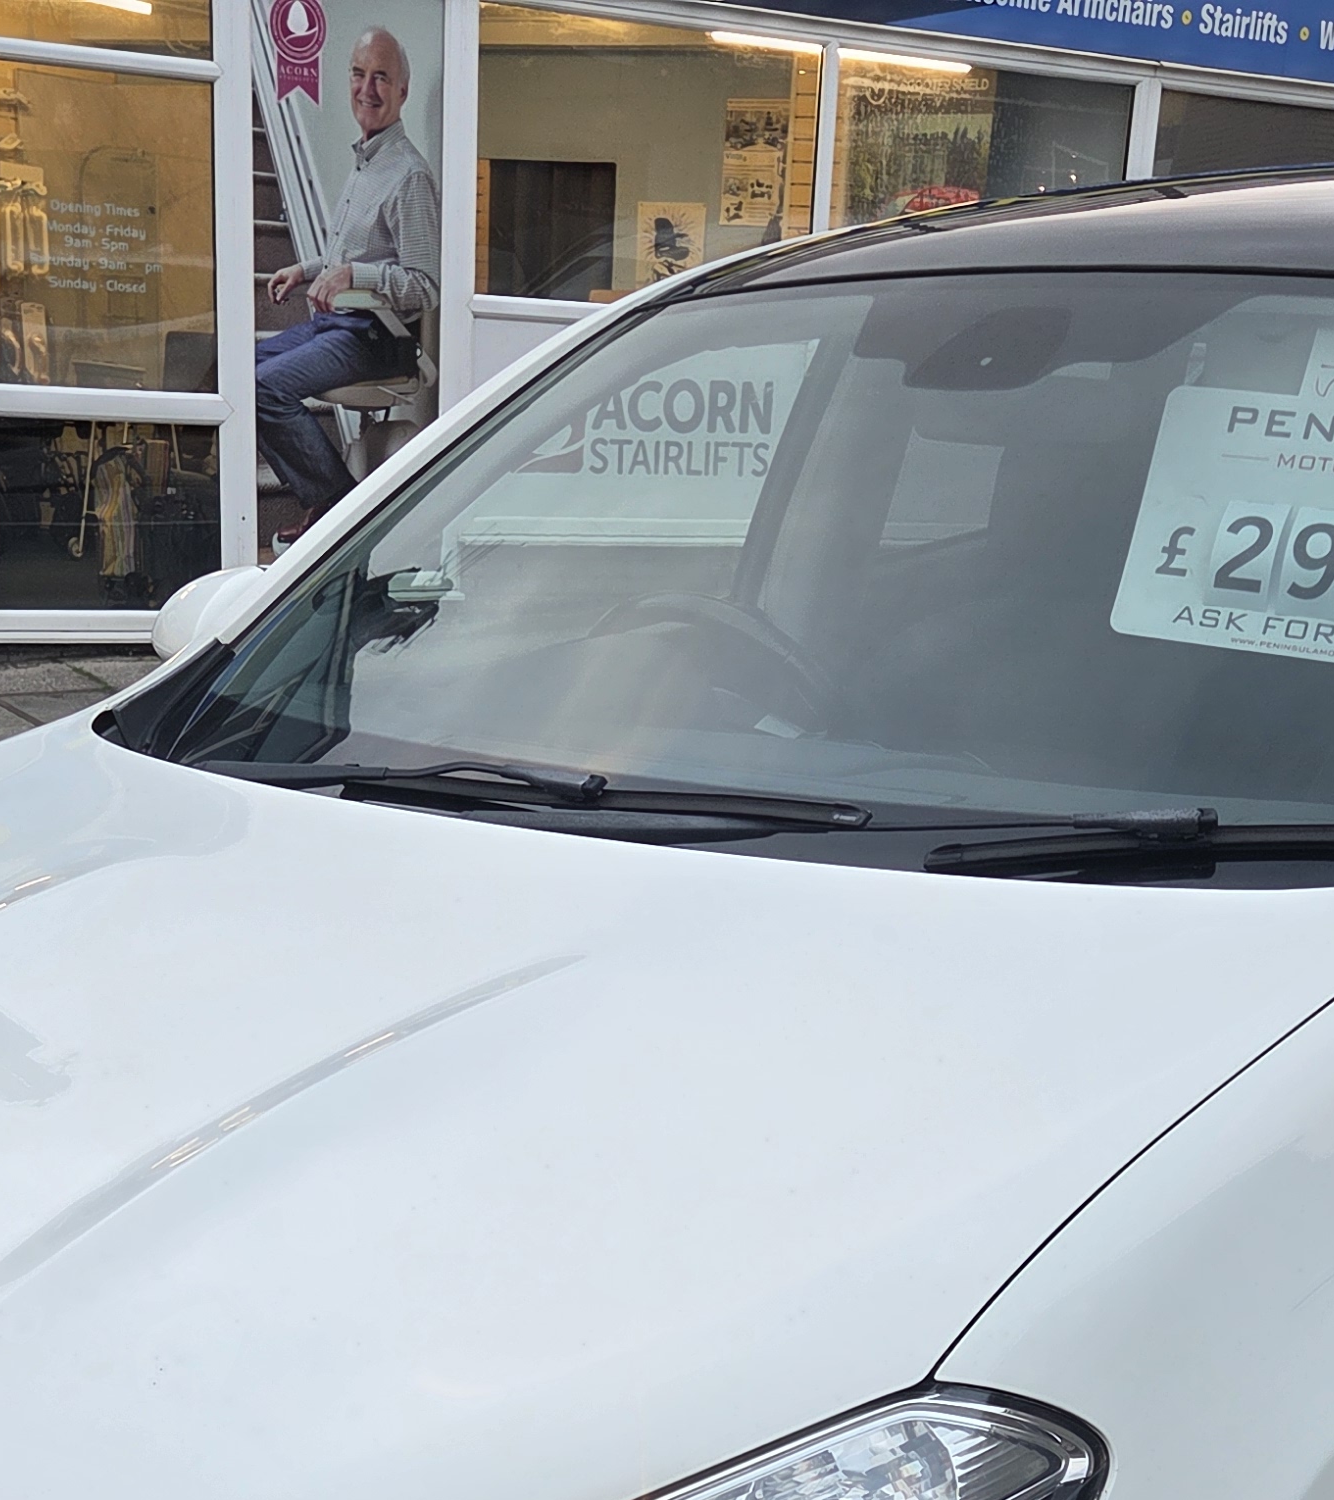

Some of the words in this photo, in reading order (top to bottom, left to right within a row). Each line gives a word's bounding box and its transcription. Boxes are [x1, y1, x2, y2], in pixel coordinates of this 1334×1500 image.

[1056, 0, 1174, 29] Armchairs
[1199, 3, 1288, 45] Stairlifts
[279, 65, 318, 78] ACORN
[952, 78, 990, 92] SHIELD
[50, 199, 101, 217] Opening
[104, 202, 140, 218] Times
[47, 220, 96, 237] Monday
[105, 224, 147, 241] Friday
[64, 235, 93, 248] 9am
[101, 238, 129, 252] 5pm
[98, 256, 127, 271] 9am
[48, 276, 97, 293] Sunday
[105, 279, 147, 293] Closed
[591, 378, 774, 435] ACORN
[588, 437, 770, 478] STAIRLIFTS
[1172, 605, 1249, 633] ASK
